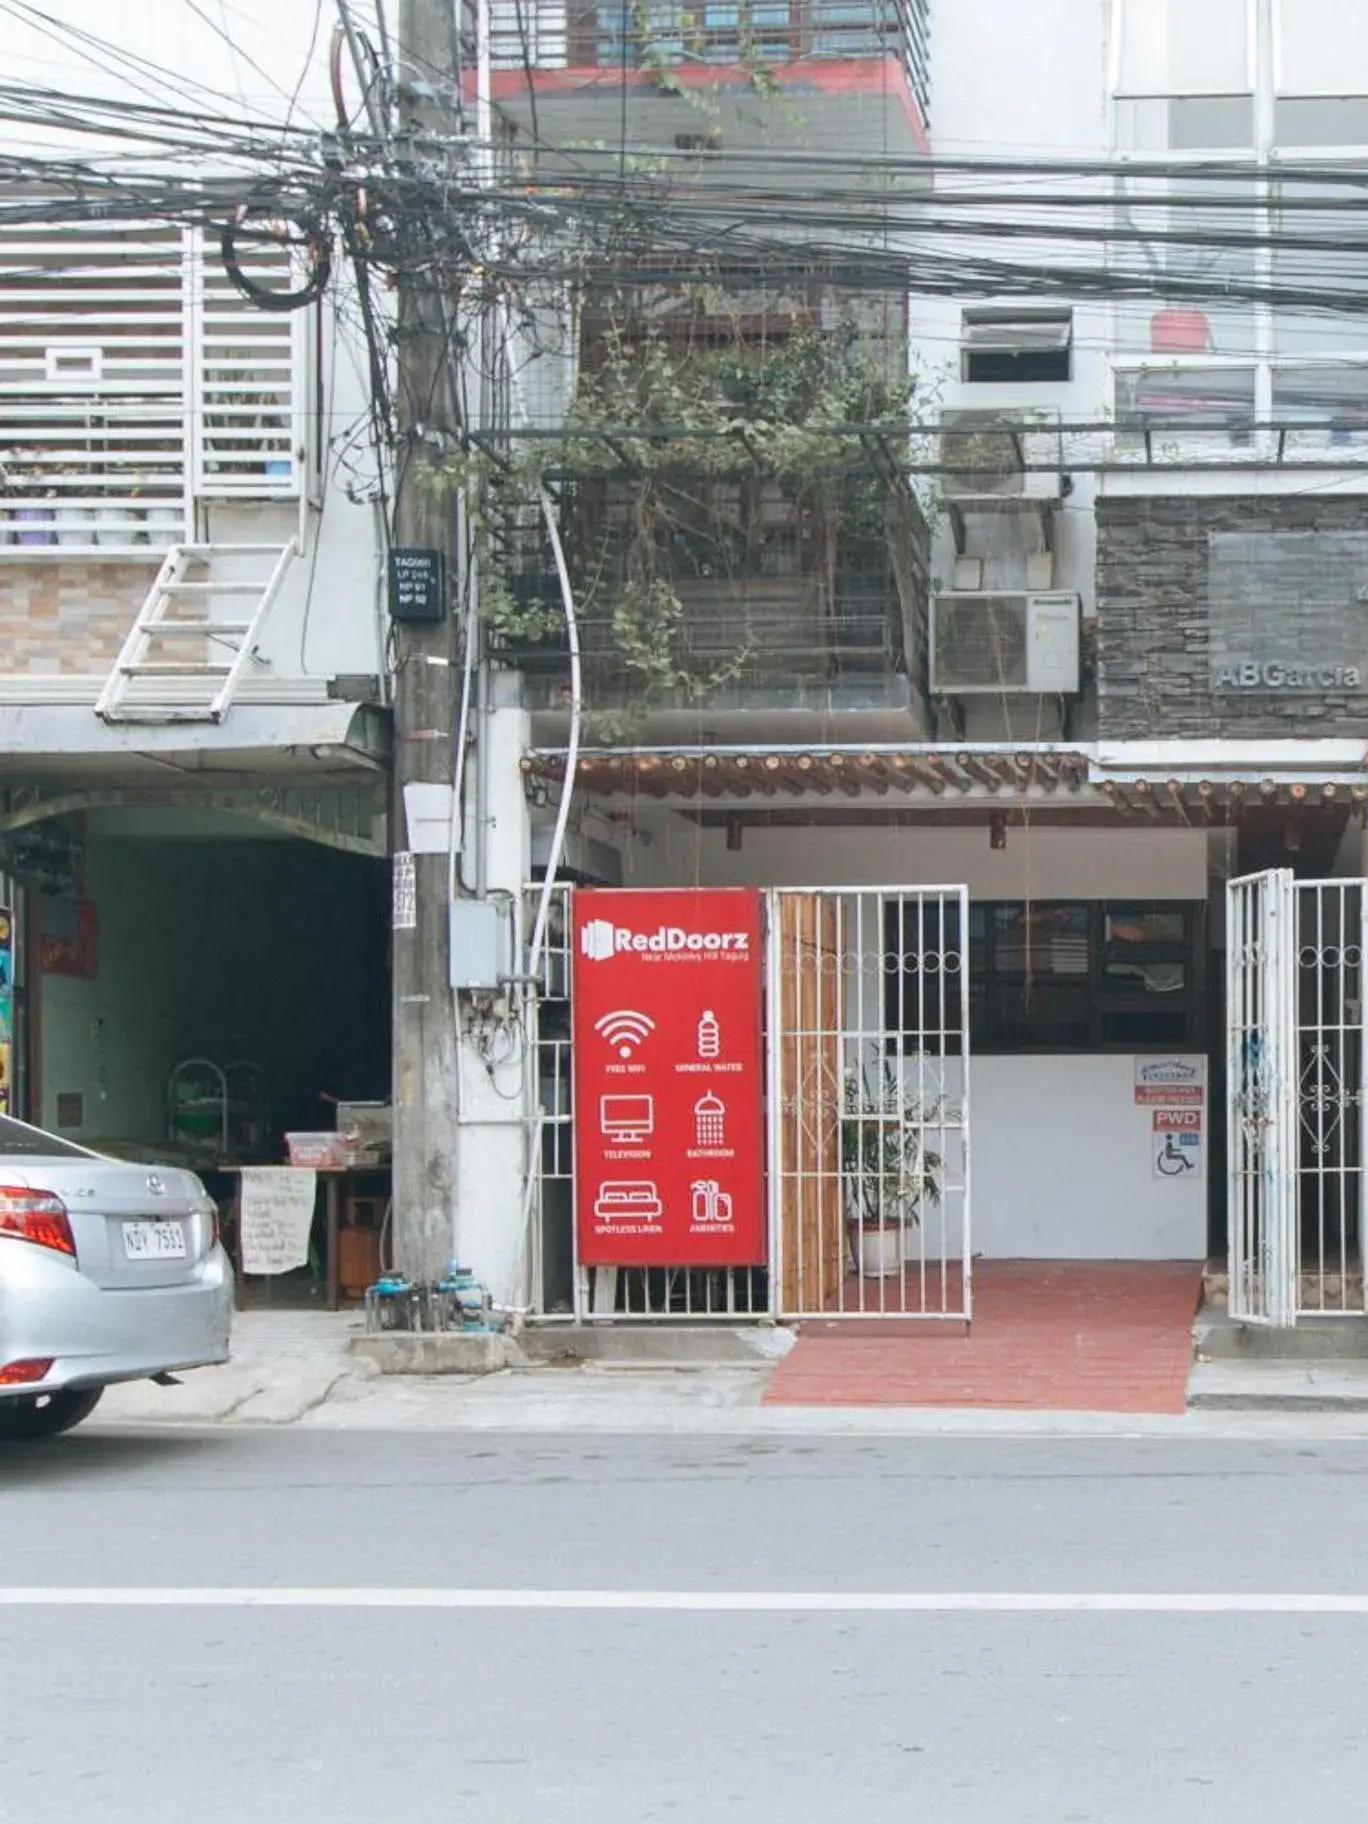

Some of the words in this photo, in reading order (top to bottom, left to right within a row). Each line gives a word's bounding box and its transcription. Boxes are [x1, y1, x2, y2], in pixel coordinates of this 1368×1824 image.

[1214, 659, 1360, 688] ABGarcia
[614, 926, 750, 952] RedDoorz
[1155, 1111, 1198, 1125] PWD
[603, 1149, 652, 1159] TELEVISION
[595, 1224, 638, 1235] SPOTLESS
